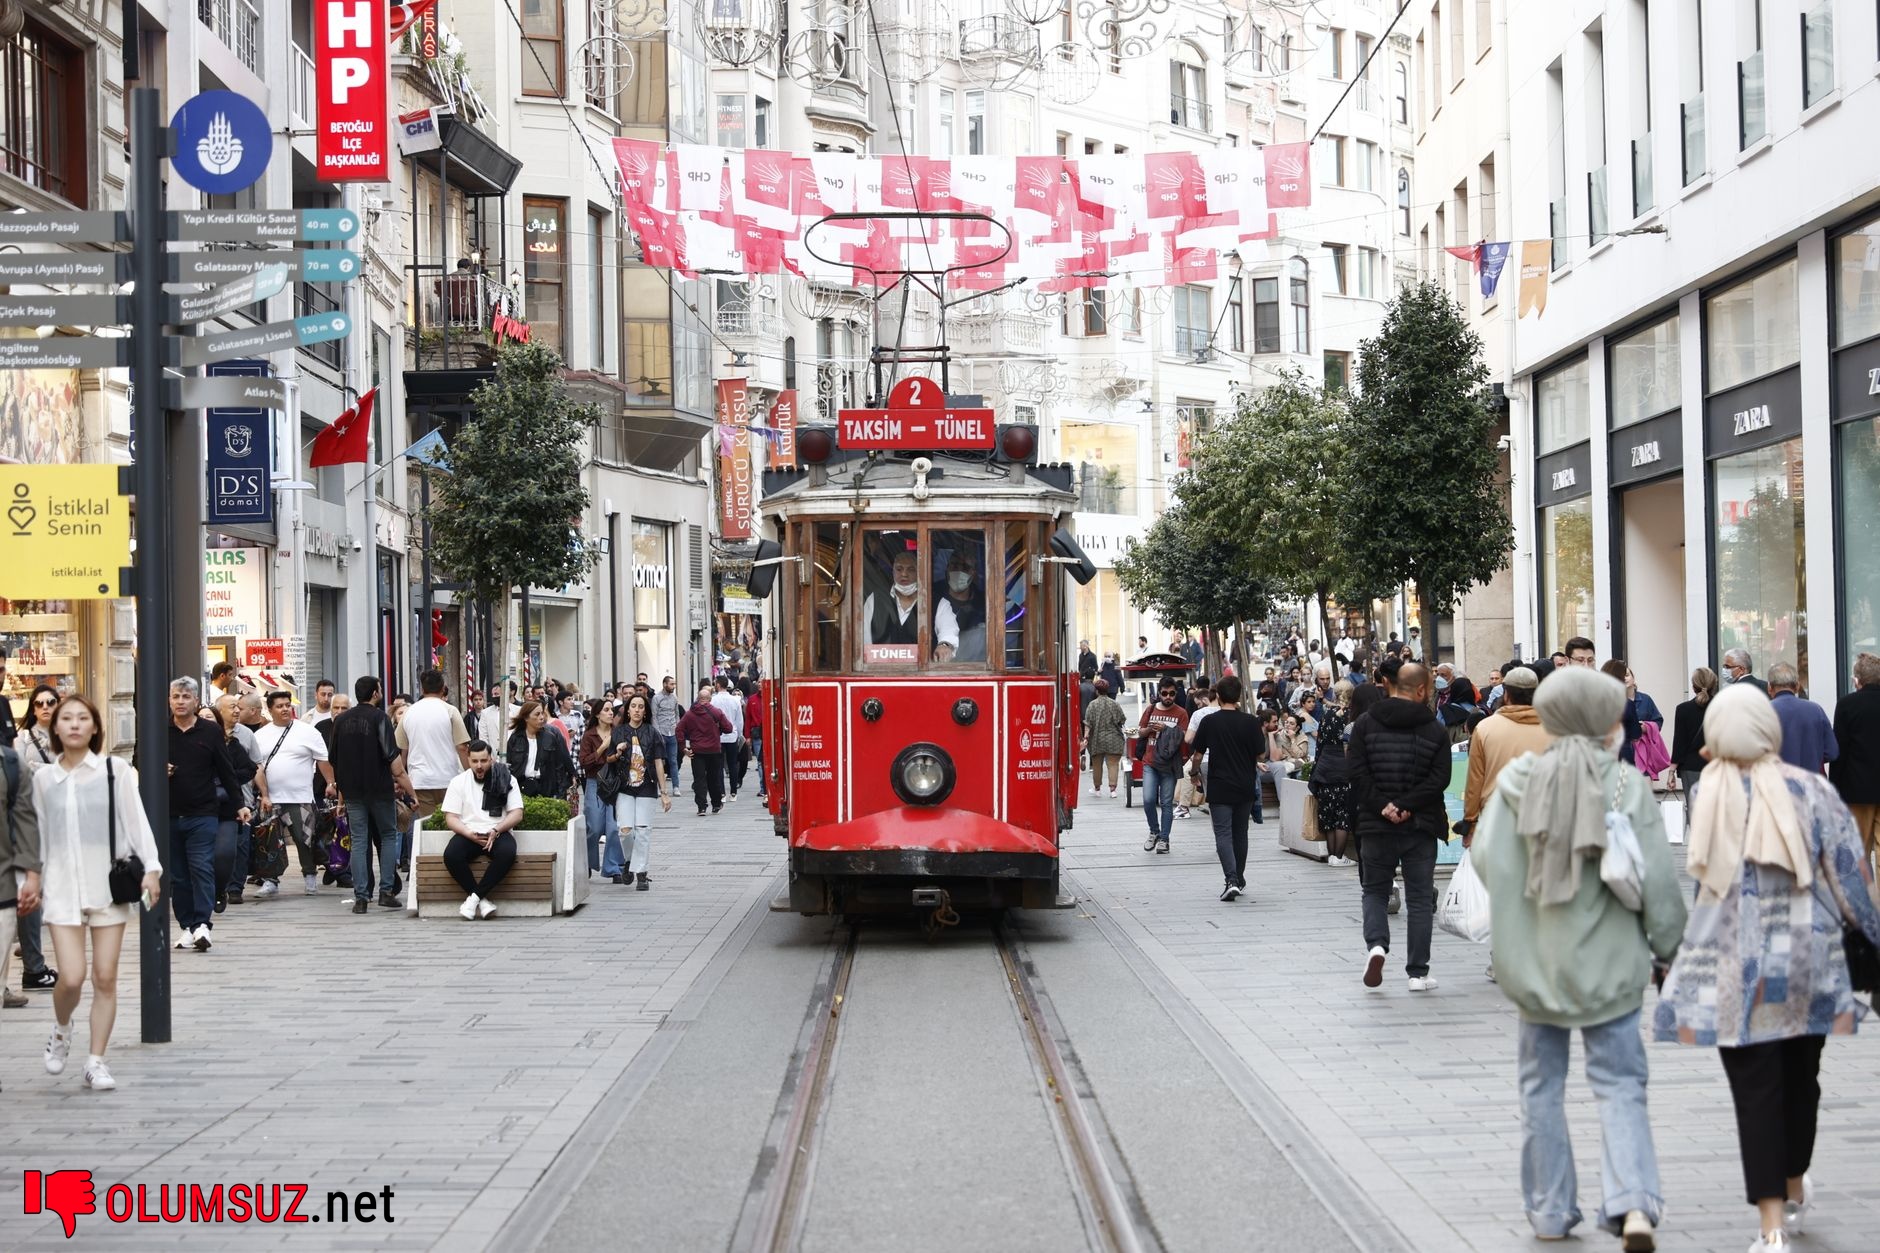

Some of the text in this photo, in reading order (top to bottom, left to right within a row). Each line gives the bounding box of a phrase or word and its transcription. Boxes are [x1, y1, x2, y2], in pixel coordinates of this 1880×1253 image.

[330, 119, 374, 133] BEYOĞLU
[342, 136, 362, 152] İLÇE
[324, 152, 380, 168] BAŞKANLIĞI
[184, 213, 296, 226] Yapı Kredi Kültür Sanat
[306, 221, 329, 230] 40 m
[50, 222, 80, 234] Pasajı
[257, 225, 297, 235] Merkezi
[0, 263, 104, 276] Avrupa (Aynalı) Pasajı
[194, 261, 253, 274] Galatasaray
[307, 262, 319, 270] 70
[181, 293, 222, 309] Galatasaray
[27, 305, 56, 318] Pasajı
[182, 309, 206, 320] Kültür
[301, 324, 329, 335] 130 m
[208, 329, 293, 352] Galatasaray Lisesi
[244, 387, 268, 398] Atlas
[909, 380, 922, 405] 2
[1733, 404, 1772, 436] ZARA
[844, 414, 902, 440] TAKSİM
[935, 414, 986, 440] TÜNEL
[1631, 440, 1661, 467] ZARA
[219, 475, 259, 495] D'S
[1552, 467, 1576, 491] ZARA
[733, 458, 751, 530] SÜRÜCÜ
[48, 495, 110, 516] İstiklal
[220, 497, 259, 506] damat
[48, 519, 102, 536] Senin
[51, 566, 103, 577] istiklal.ist
[216, 621, 248, 635] HEYETİ
[18, 648, 47, 666] KOSKA
[870, 647, 915, 659] TÜNEL
[797, 704, 813, 725] 223
[1031, 704, 1046, 725] 223
[1032, 740, 1043, 748] ALO
[811, 760, 831, 769] YASAK
[1018, 760, 1042, 769] ASILMAK
[798, 770, 833, 781] TEHLİKELİDİR
[1016, 771, 1025, 780] VE
